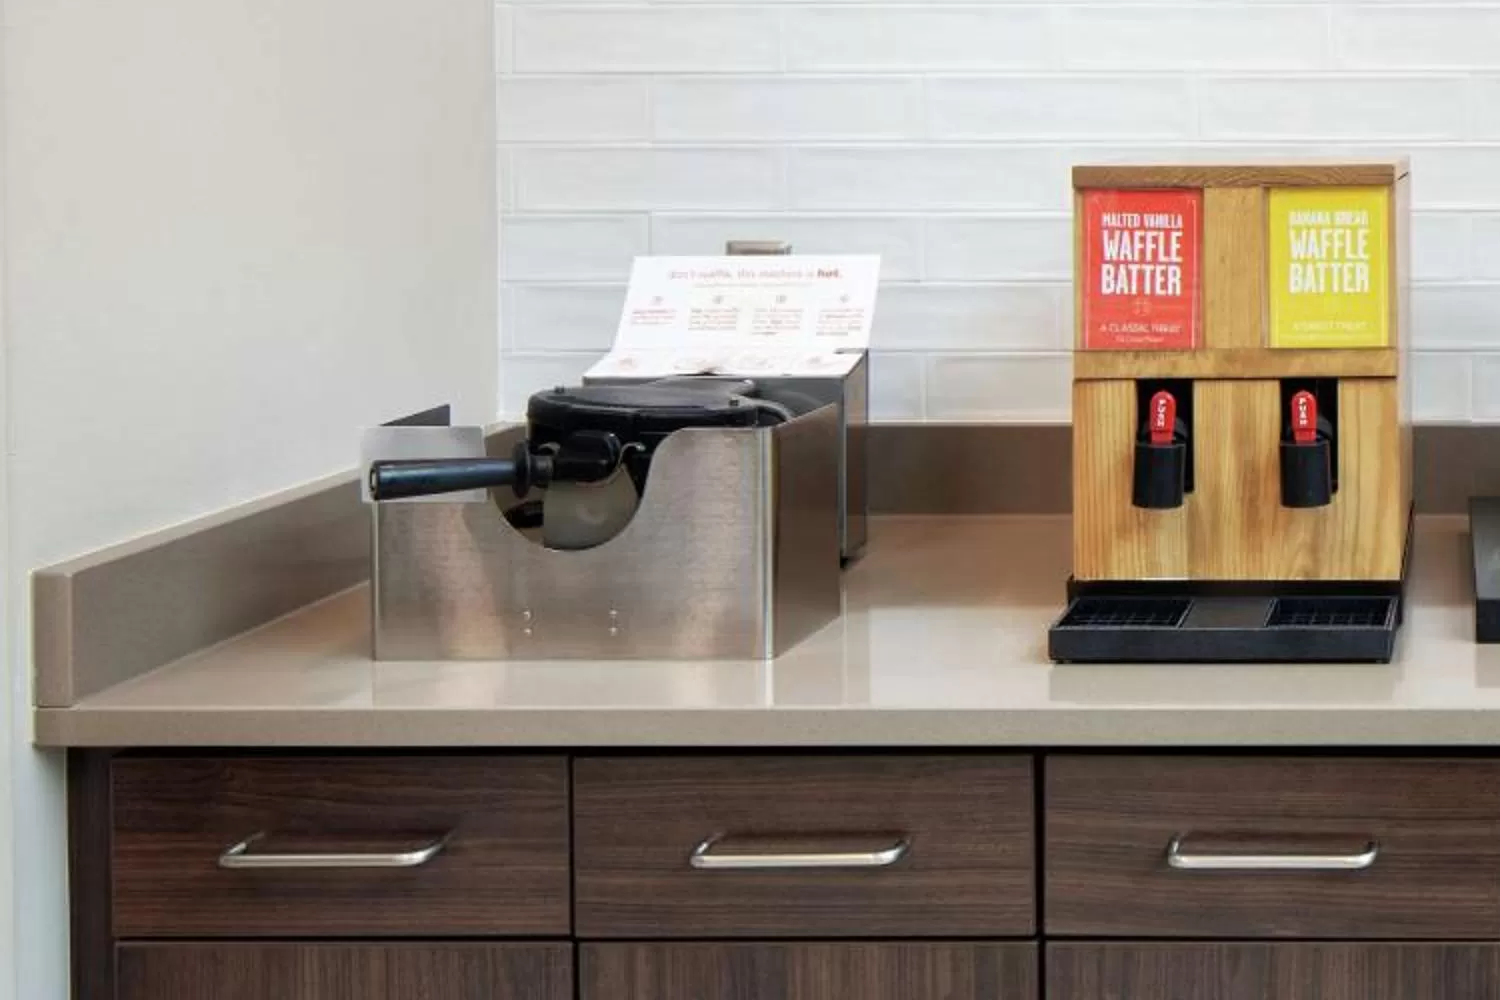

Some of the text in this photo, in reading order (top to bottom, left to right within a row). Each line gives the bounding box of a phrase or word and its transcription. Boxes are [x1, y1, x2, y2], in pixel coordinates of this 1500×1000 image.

[1102, 212, 1184, 229] MALTED VANILLA
[1102, 230, 1183, 262] WAFFLE
[1289, 228, 1370, 260] WAFFLE
[1101, 263, 1182, 296] BATTER
[1289, 261, 1369, 294] BATTER
